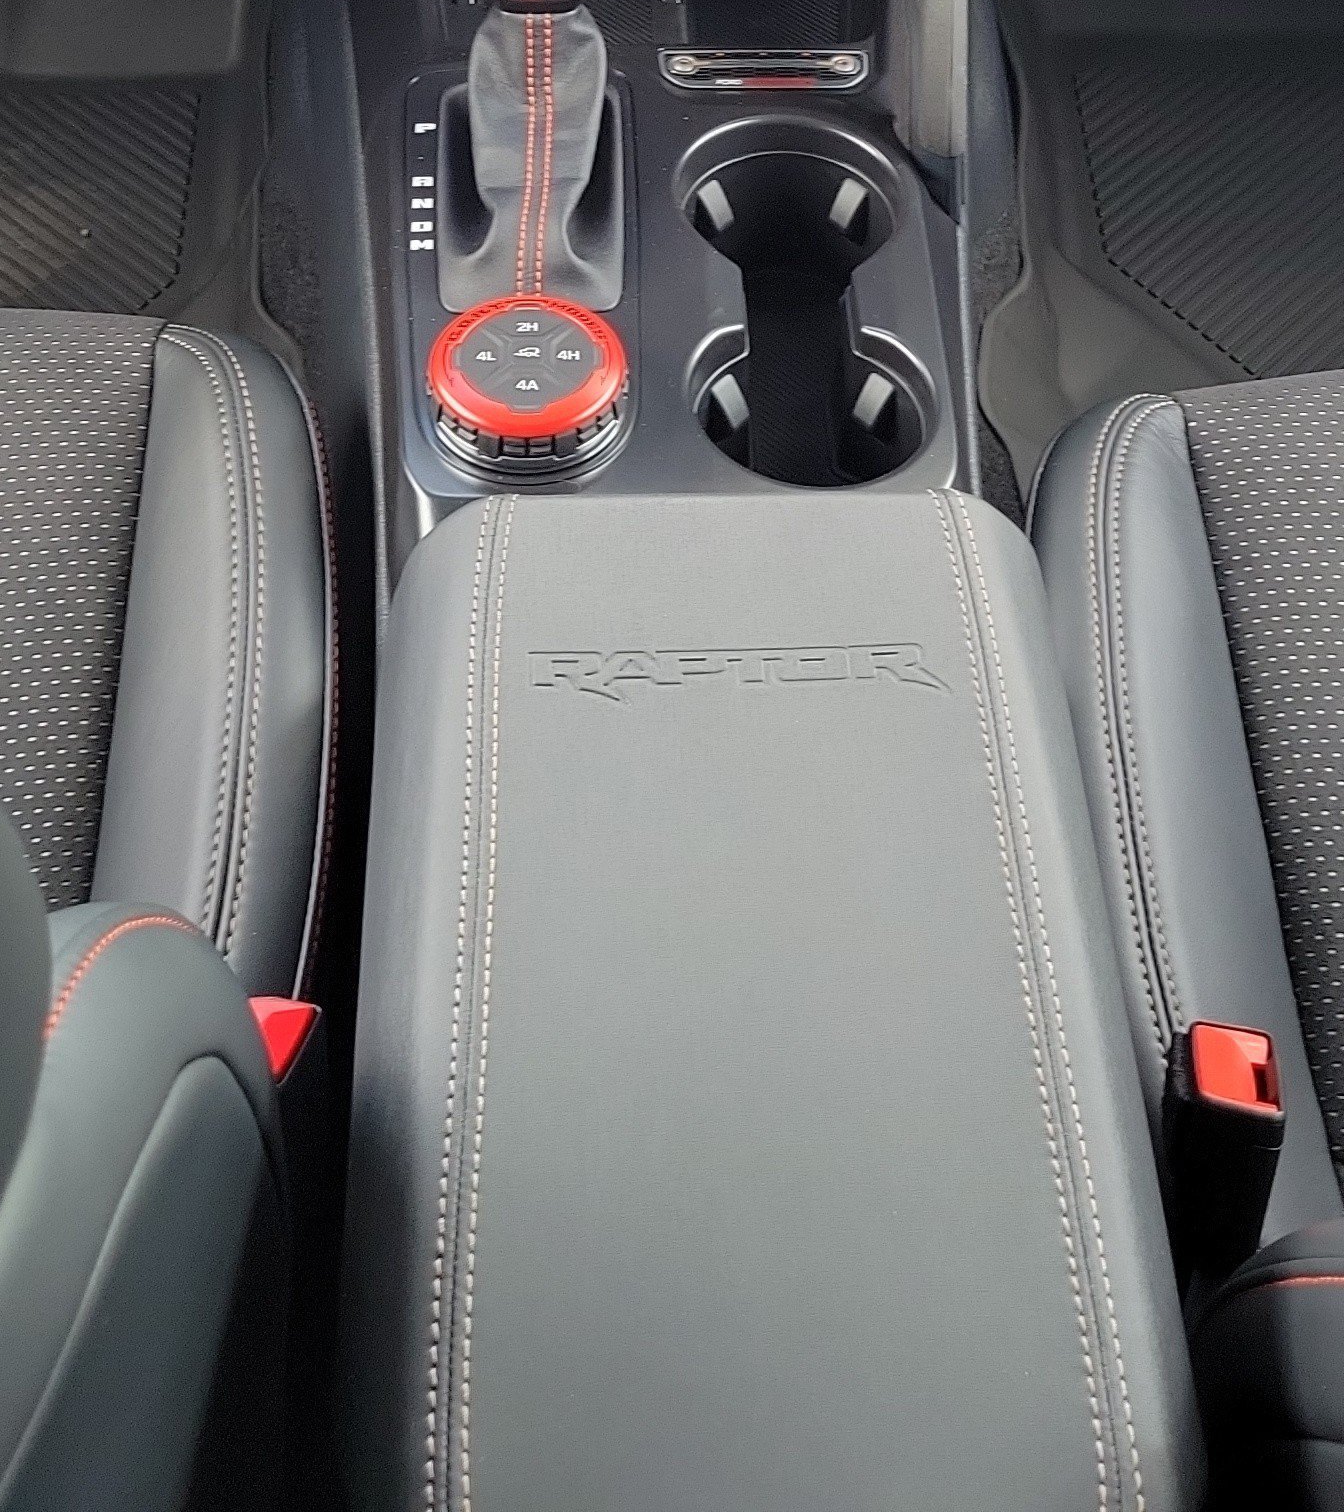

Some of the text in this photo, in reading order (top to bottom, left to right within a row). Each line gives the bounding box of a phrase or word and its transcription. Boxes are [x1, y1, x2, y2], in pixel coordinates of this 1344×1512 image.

[414, 123, 437, 133] P
[411, 198, 434, 208] N
[410, 221, 433, 232] D
[410, 239, 434, 250] M
[516, 322, 539, 332] 2H
[476, 351, 497, 361] 4L
[557, 350, 580, 361] 4H
[515, 379, 539, 391] 4A
[528, 643, 953, 705] RAPTOR
